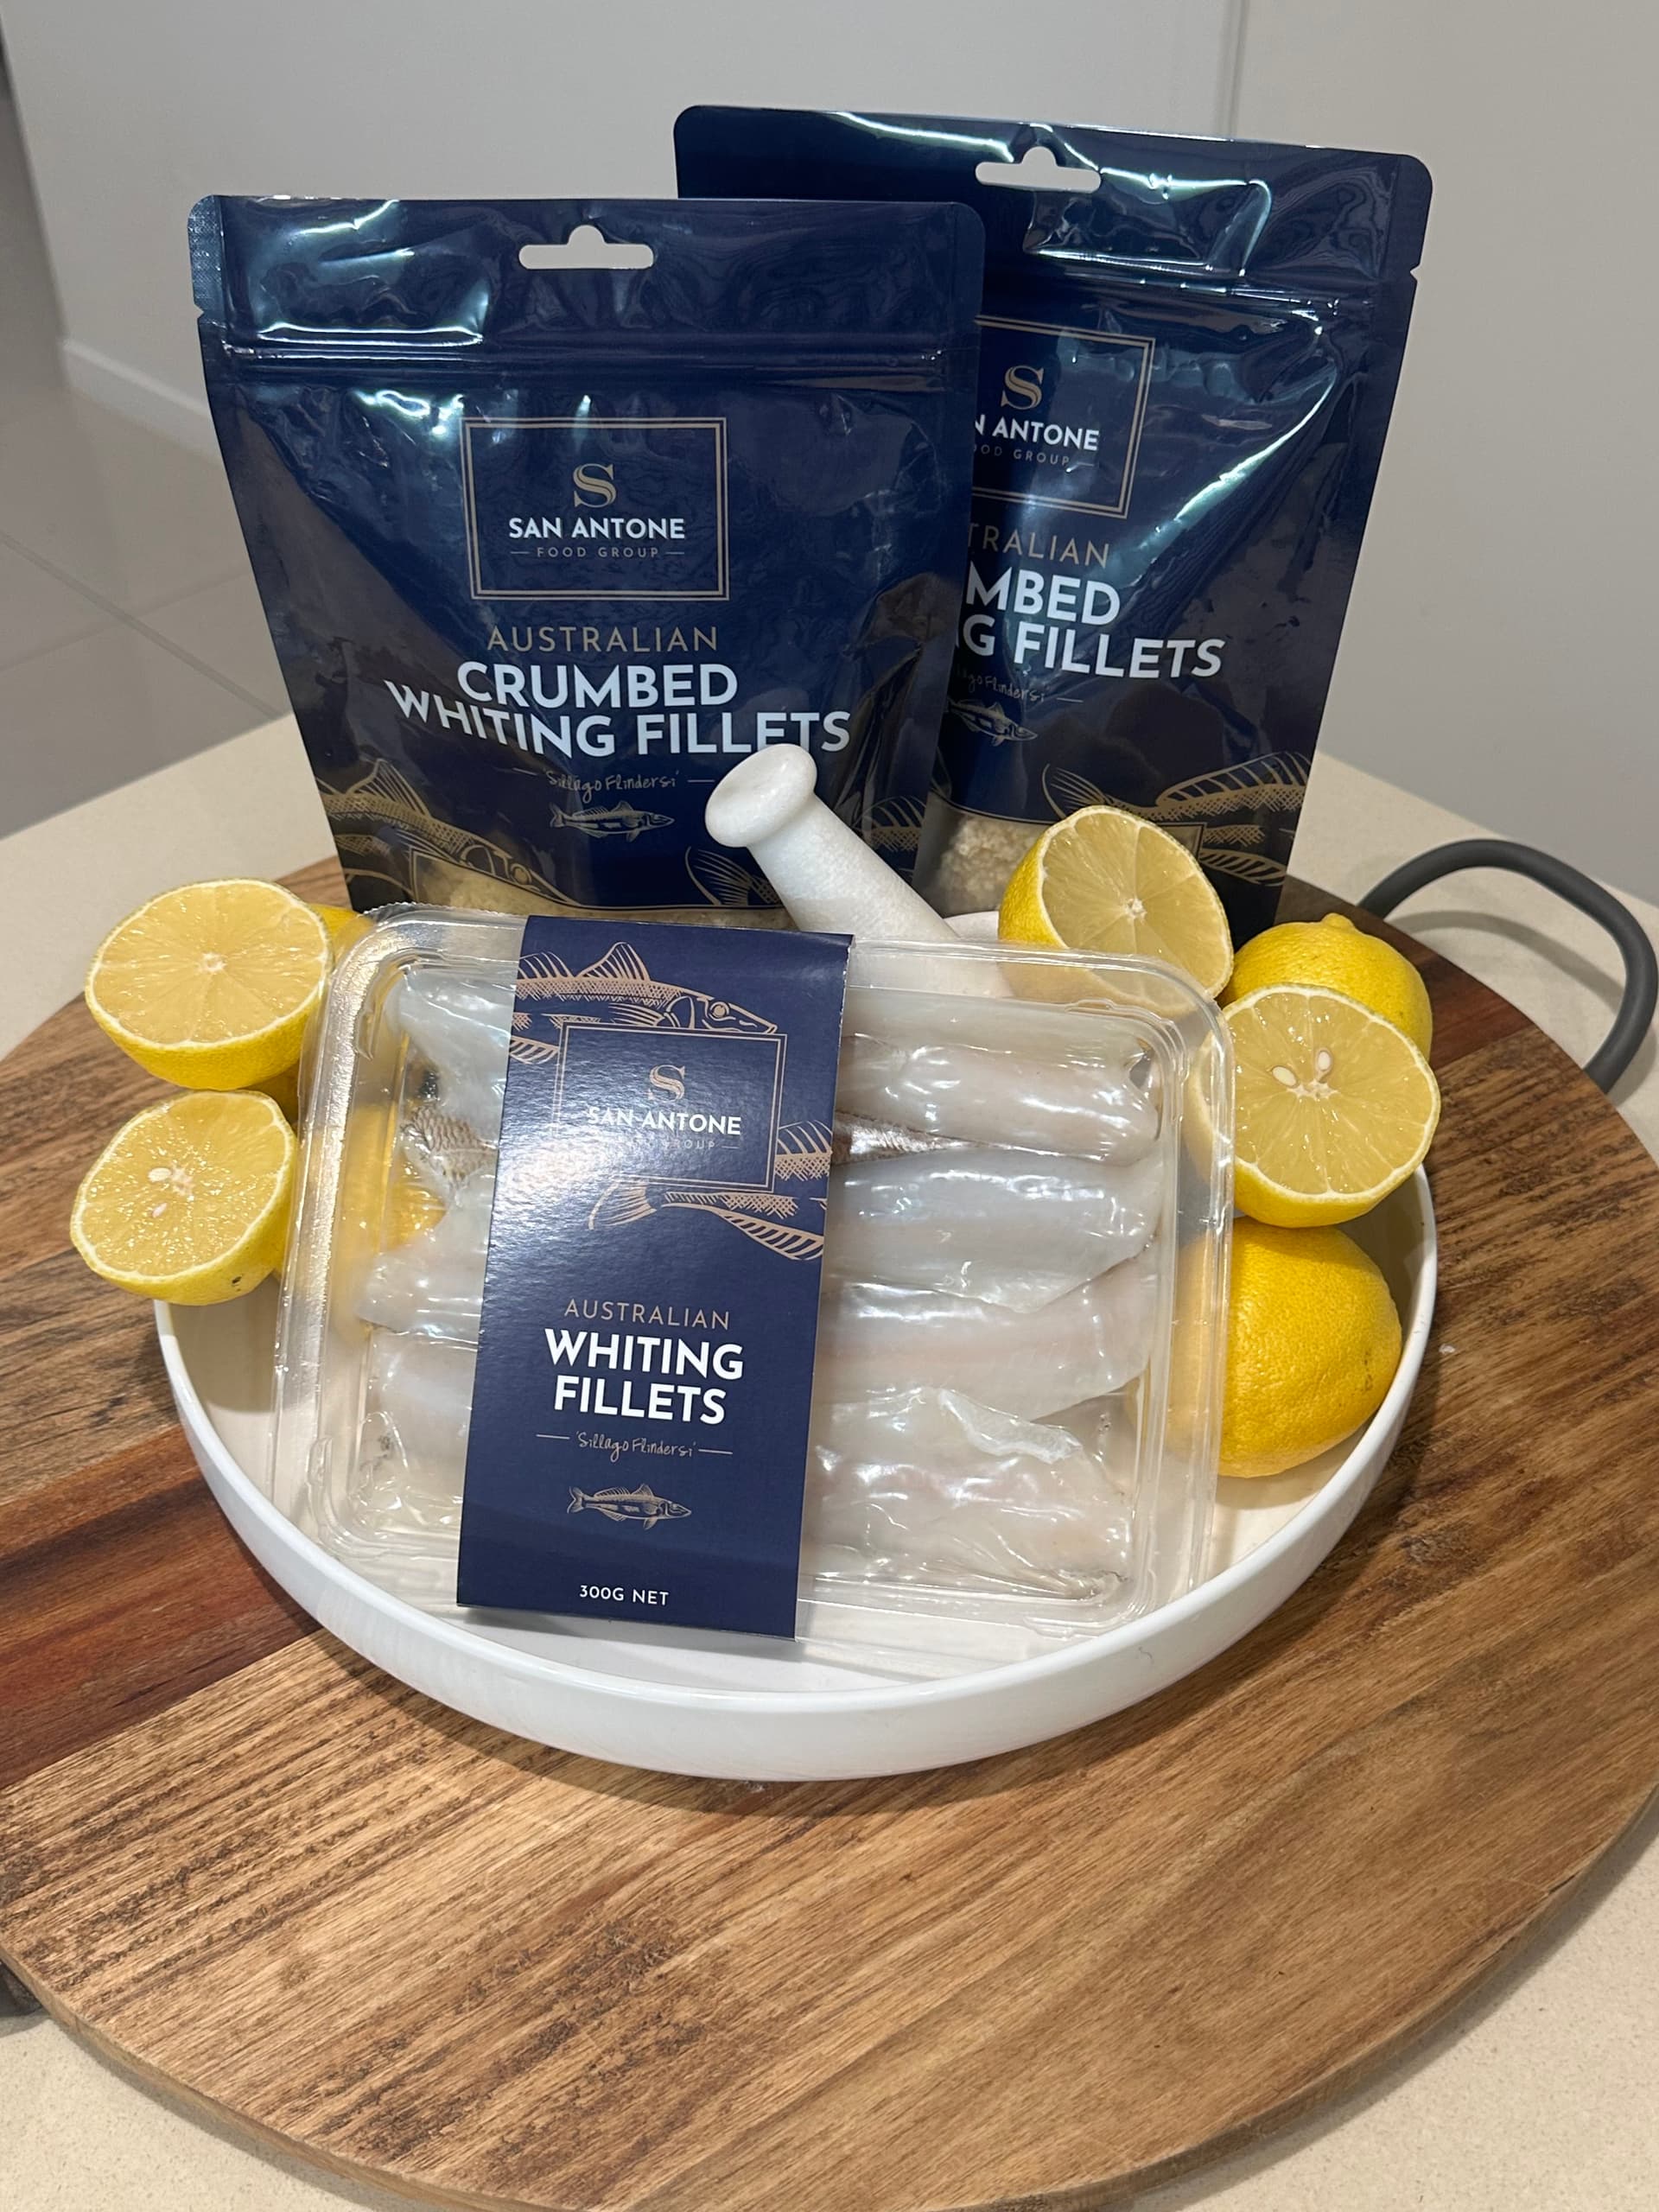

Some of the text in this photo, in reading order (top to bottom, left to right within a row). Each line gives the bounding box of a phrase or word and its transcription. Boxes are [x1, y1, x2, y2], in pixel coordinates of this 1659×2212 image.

[992, 416, 1100, 451] ANTONE
[1014, 449, 1070, 466] GROUP
[508, 518, 685, 539] SAN ANTONE
[537, 547, 659, 558] FOOD GROUP
[968, 523, 1109, 569] TRALIAN
[966, 561, 1121, 626] MBED
[487, 626, 718, 652] AUSTRALIAN
[1014, 621, 1226, 679] FILLETS
[456, 661, 738, 709] CRUMBED
[384, 679, 851, 759] WHITING FILLETS
[587, 1106, 741, 1135] SAN ANTONE
[661, 1138, 715, 1150] OUP
[564, 1298, 730, 1330] AUSTRALIAN
[544, 1328, 744, 1380] WHITING
[554, 1375, 727, 1425] FILLETS
[579, 1585, 670, 1606] 300G NET
